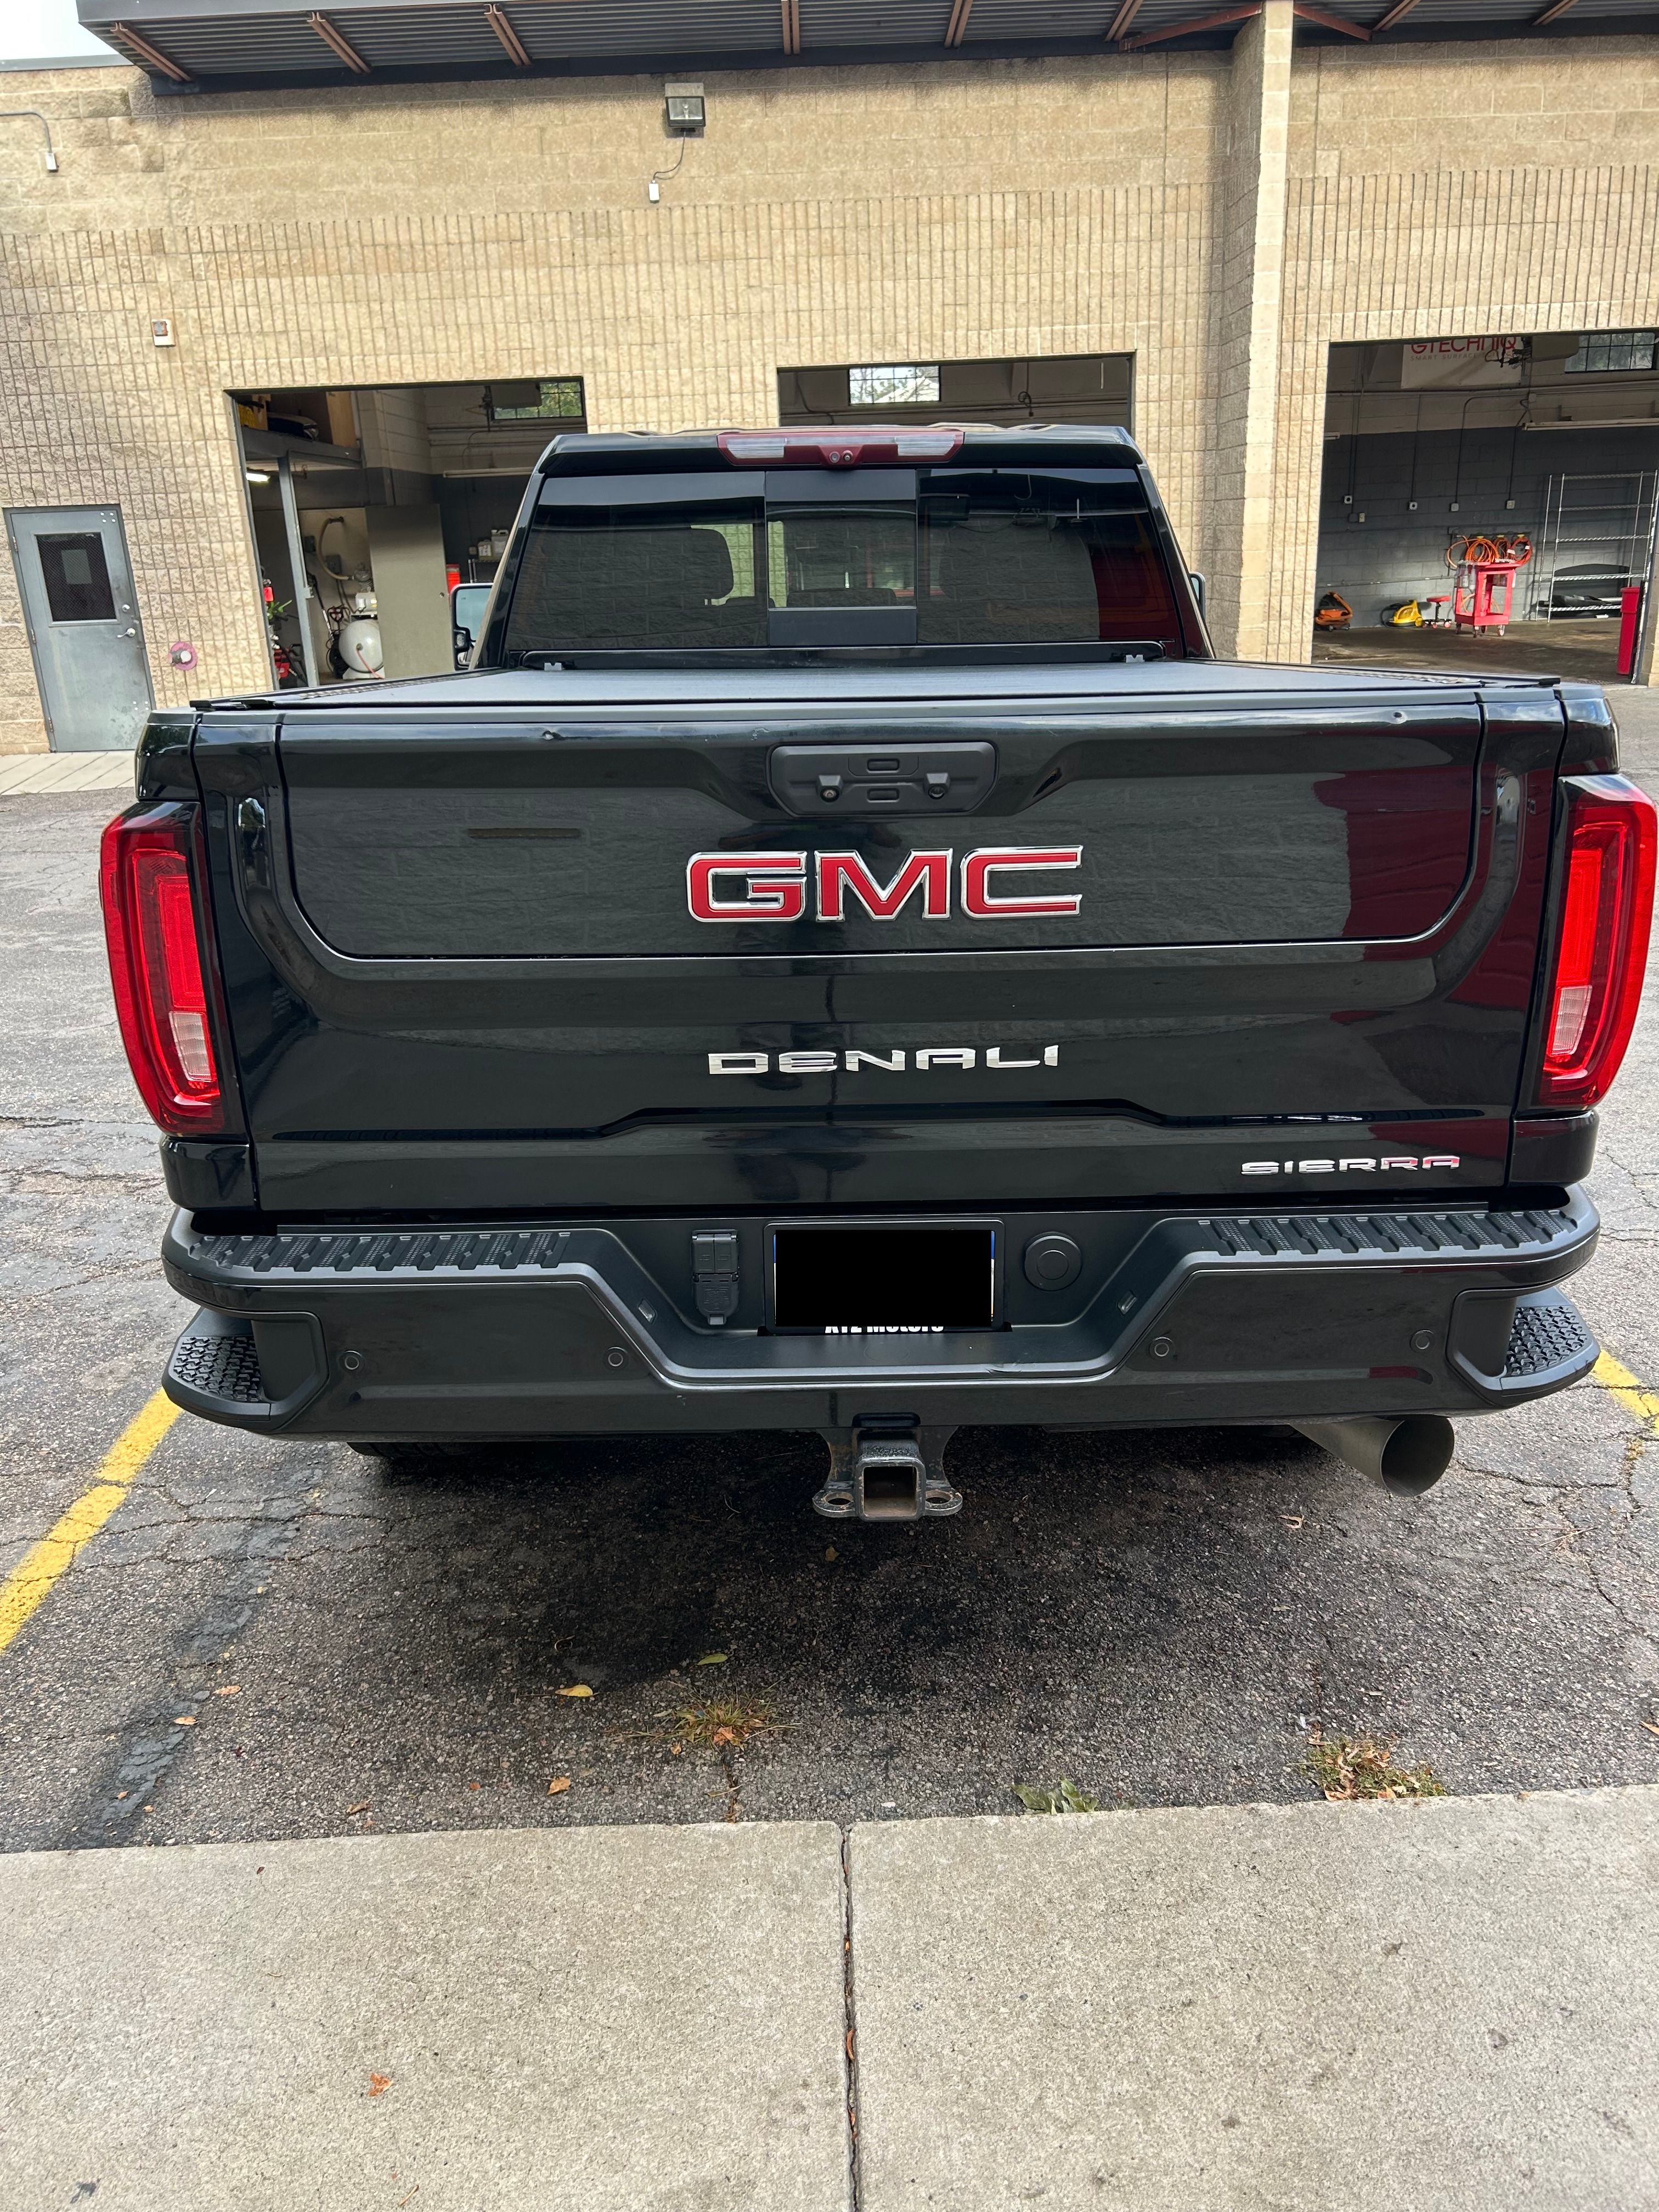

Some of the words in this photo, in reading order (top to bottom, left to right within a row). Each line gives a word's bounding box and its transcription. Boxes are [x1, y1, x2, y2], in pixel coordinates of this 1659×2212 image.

[1442, 352, 1478, 360] SURFACE
[687, 845, 1084, 923] GMC
[708, 1045, 1059, 1075] DENALI
[1241, 1155, 1460, 1176] SIERRA
